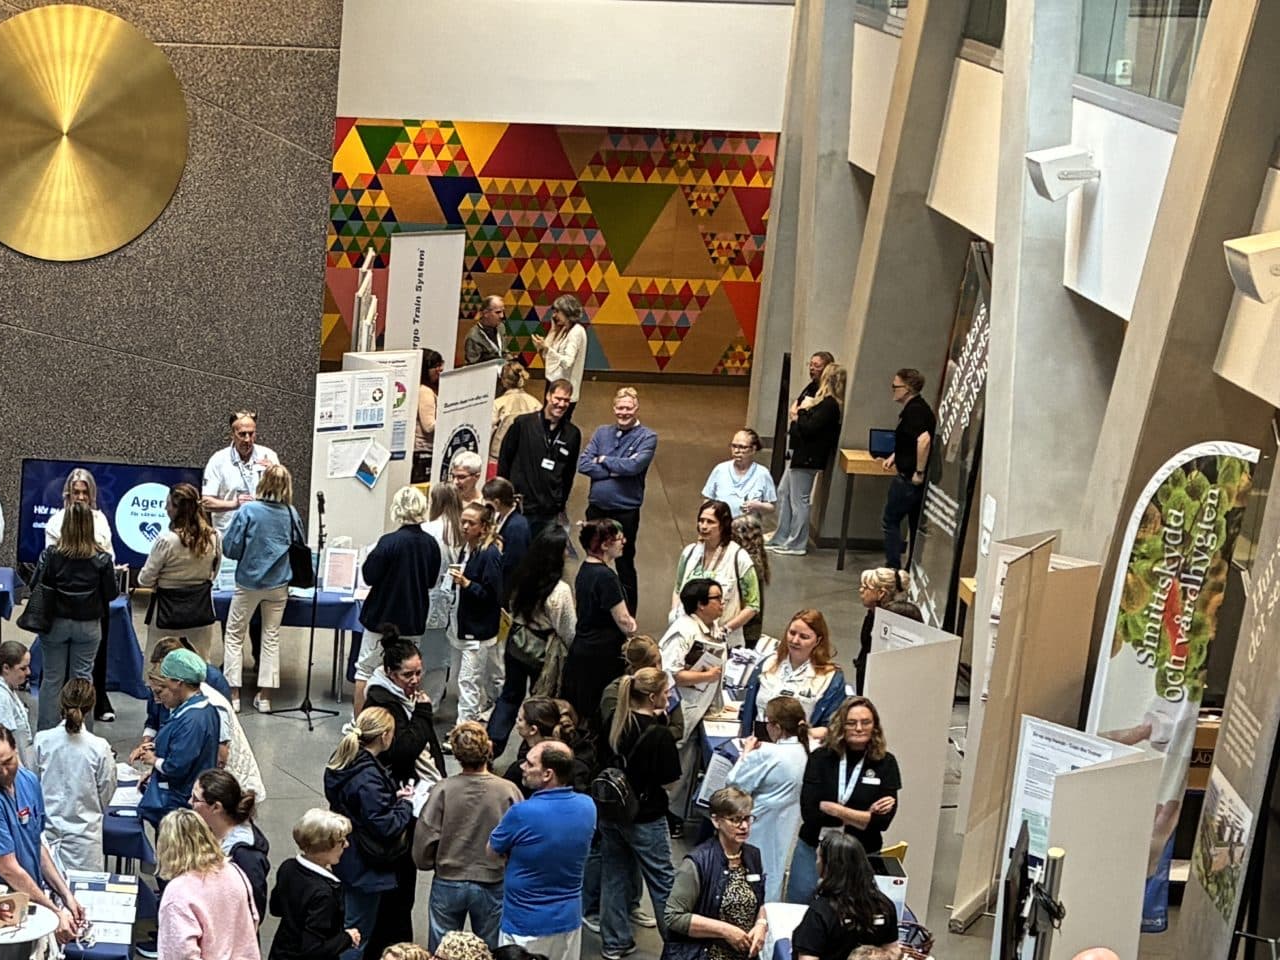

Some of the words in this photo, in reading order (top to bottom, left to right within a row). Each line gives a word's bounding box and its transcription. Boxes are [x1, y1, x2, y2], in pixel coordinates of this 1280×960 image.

[415, 249, 425, 292] System
[412, 296, 422, 325] Train
[131, 496, 166, 511] Ager
[1174, 487, 1221, 646] vårdhygien
[1136, 508, 1185, 669] Smittskydd
